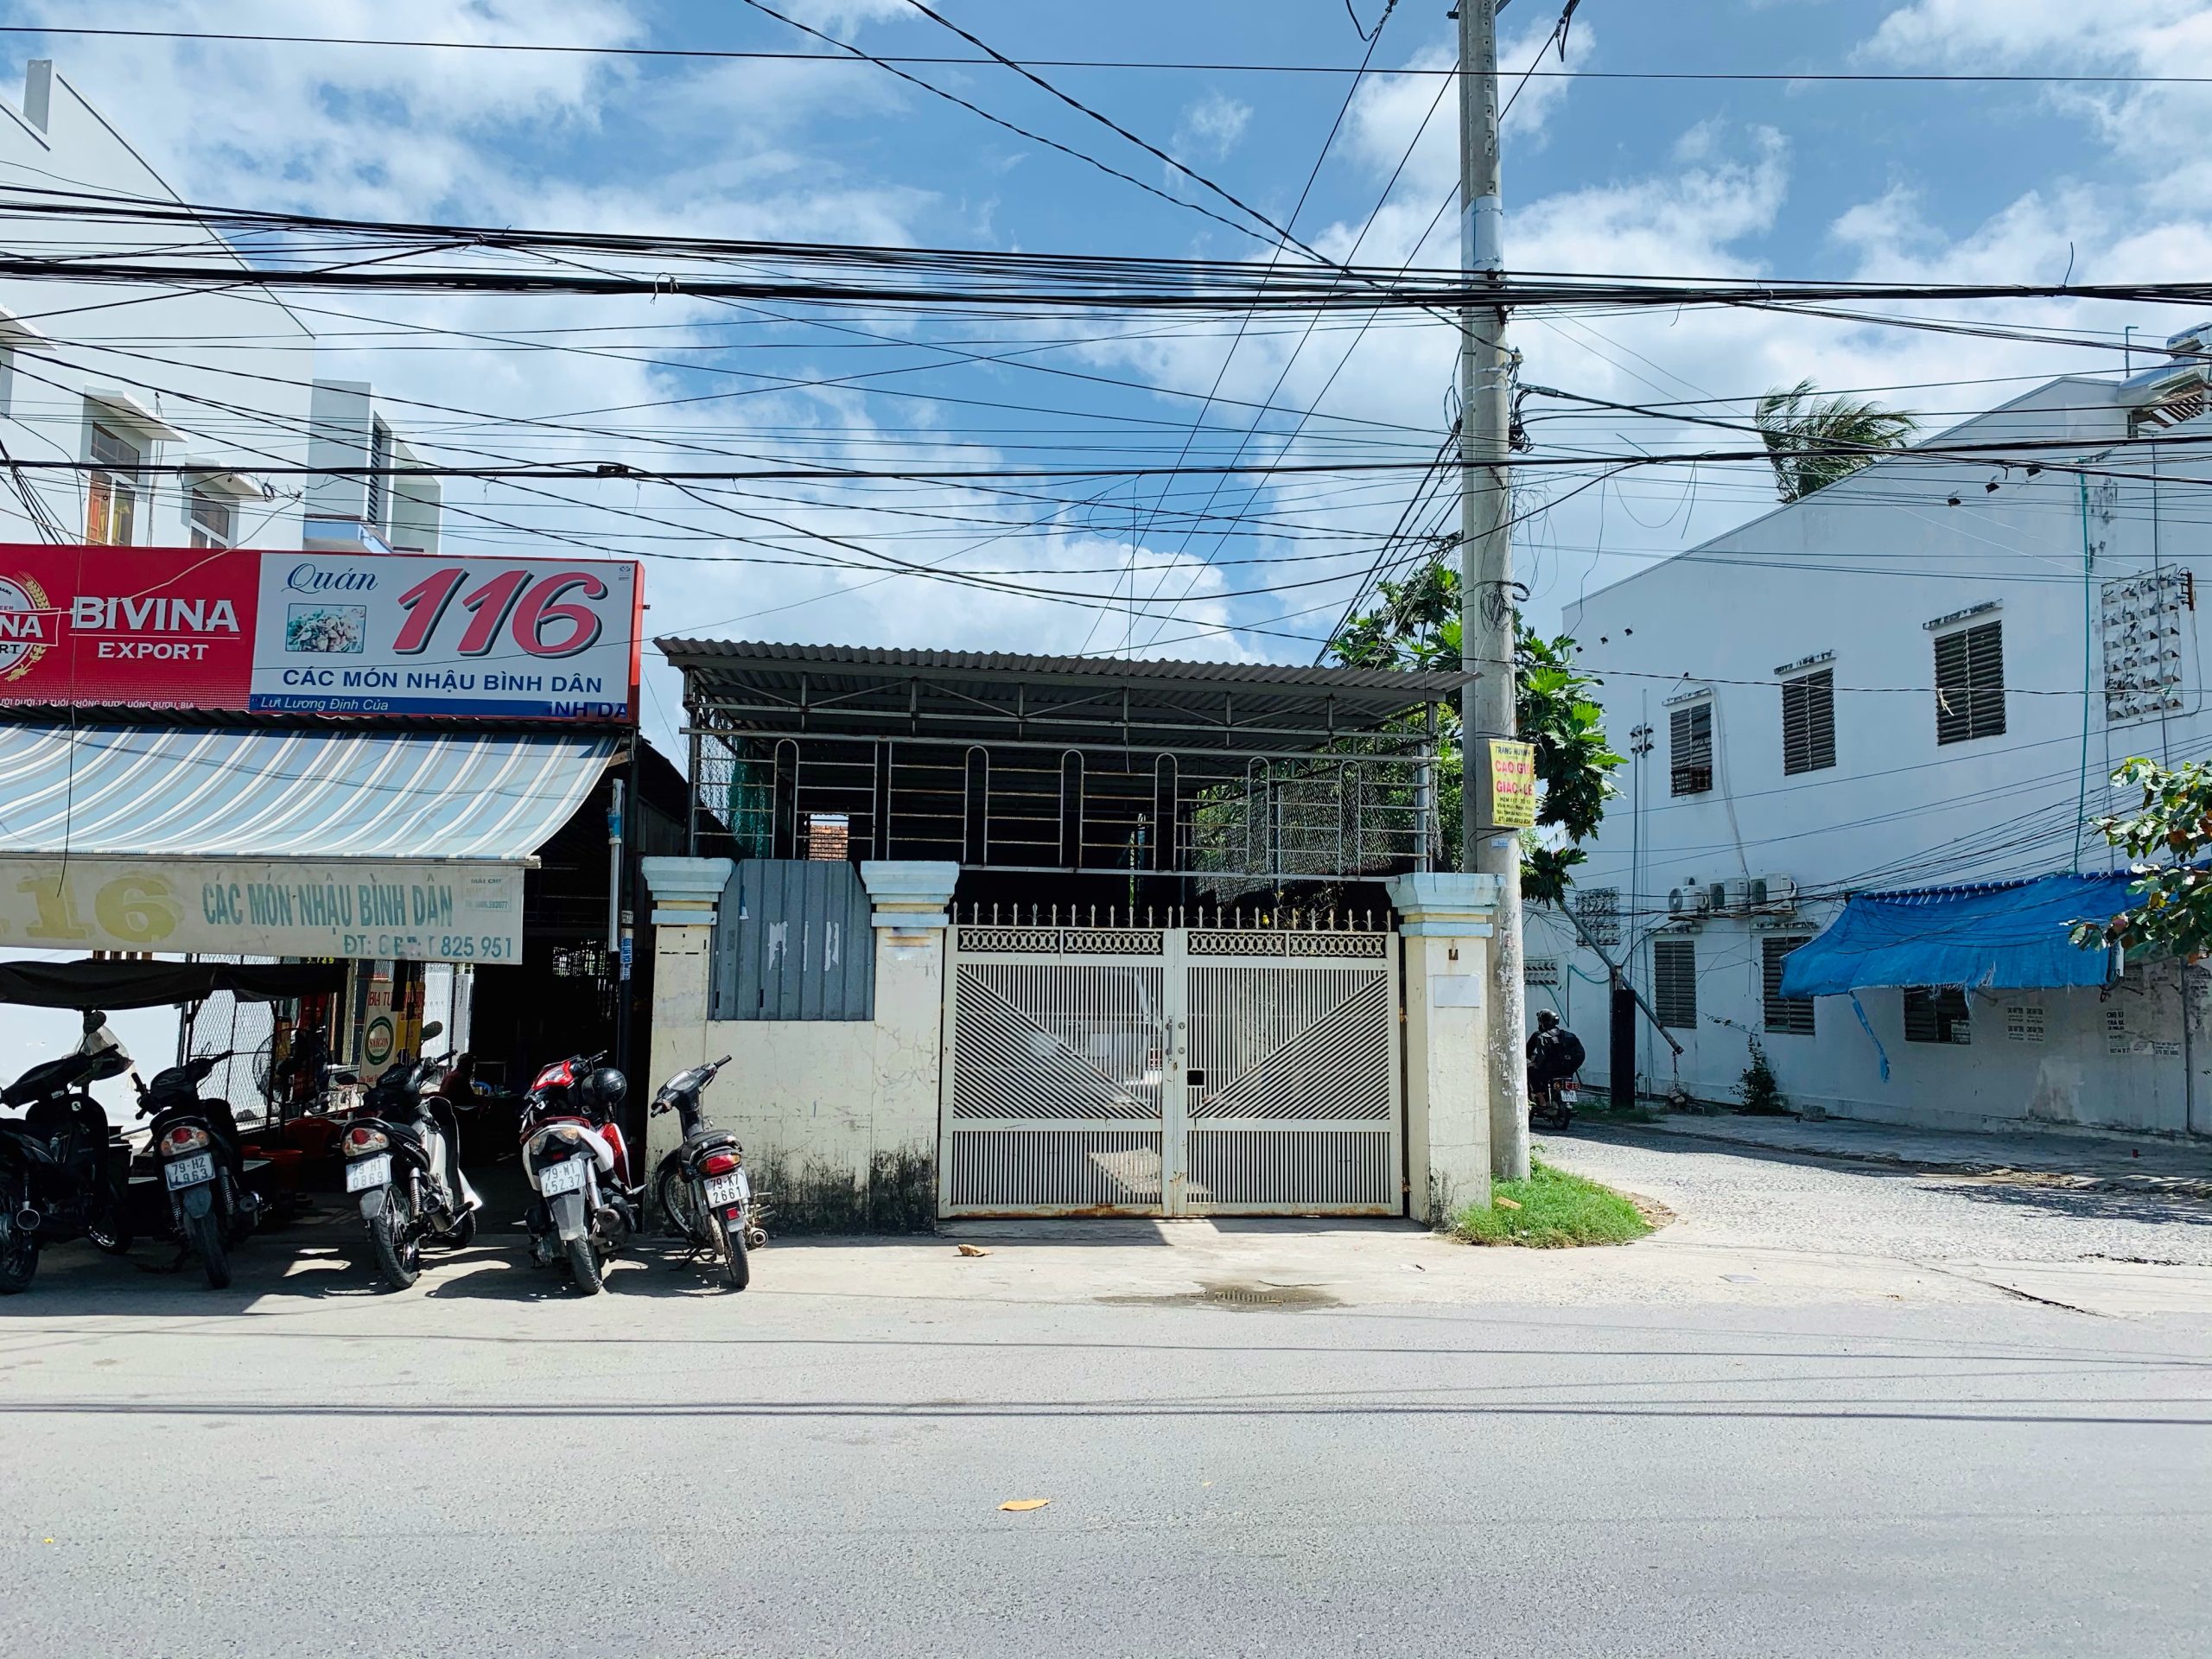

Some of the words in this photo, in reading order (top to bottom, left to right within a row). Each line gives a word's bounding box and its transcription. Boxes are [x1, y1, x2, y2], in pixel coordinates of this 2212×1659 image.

[69, 595, 241, 632] BIVINA
[281, 563, 378, 594] Quán
[392, 569, 607, 659] 116
[97, 641, 210, 660] EXPORT
[283, 667, 335, 686] CÁC
[343, 668, 398, 689] MÓN
[406, 670, 476, 692] NHẬU
[483, 671, 542, 692] BÌNH
[551, 672, 602, 693] DÂN
[329, 698, 359, 711] Định
[363, 698, 389, 710] Của
[203, 873, 243, 925] CÁC
[247, 873, 293, 926] MÓN
[297, 873, 353, 935] NHẬU
[358, 873, 407, 926] BÌNH
[411, 873, 453, 927] DÂN
[344, 934, 372, 955] ĐT:
[442, 935, 474, 957] 825
[480, 936, 512, 958] 951
[353, 1159, 381, 1177] 79-H1
[353, 1171, 384, 1189] 0869
[544, 1173, 581, 1194] 452.37
[713, 1185, 741, 1204] 2661
